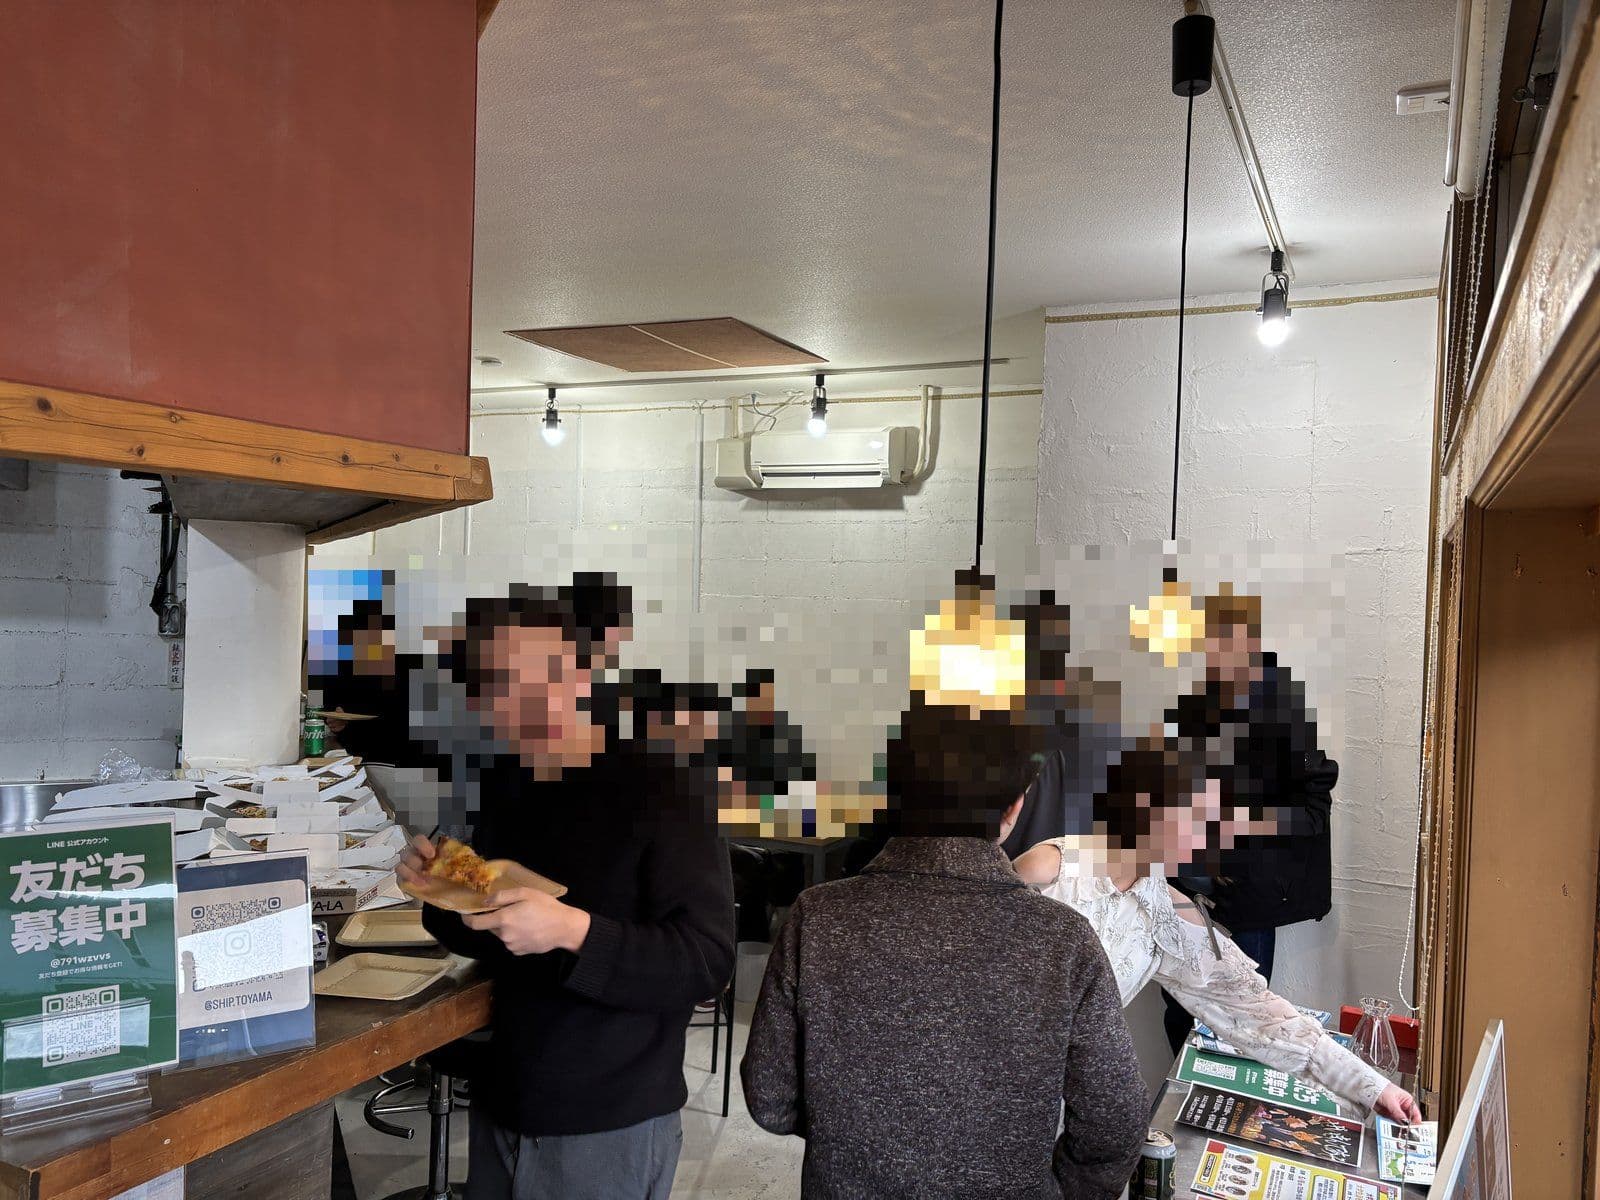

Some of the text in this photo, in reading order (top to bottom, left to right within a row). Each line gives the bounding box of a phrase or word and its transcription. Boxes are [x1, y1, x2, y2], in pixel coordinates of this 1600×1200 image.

[46, 836, 110, 849] LINE 公式アカウント
[9, 852, 146, 904] 友だち
[312, 900, 344, 912] A-LA
[10, 898, 147, 955] 募集中
[50, 952, 111, 969] @791wzvvs
[70, 1018, 94, 1032] LINE
